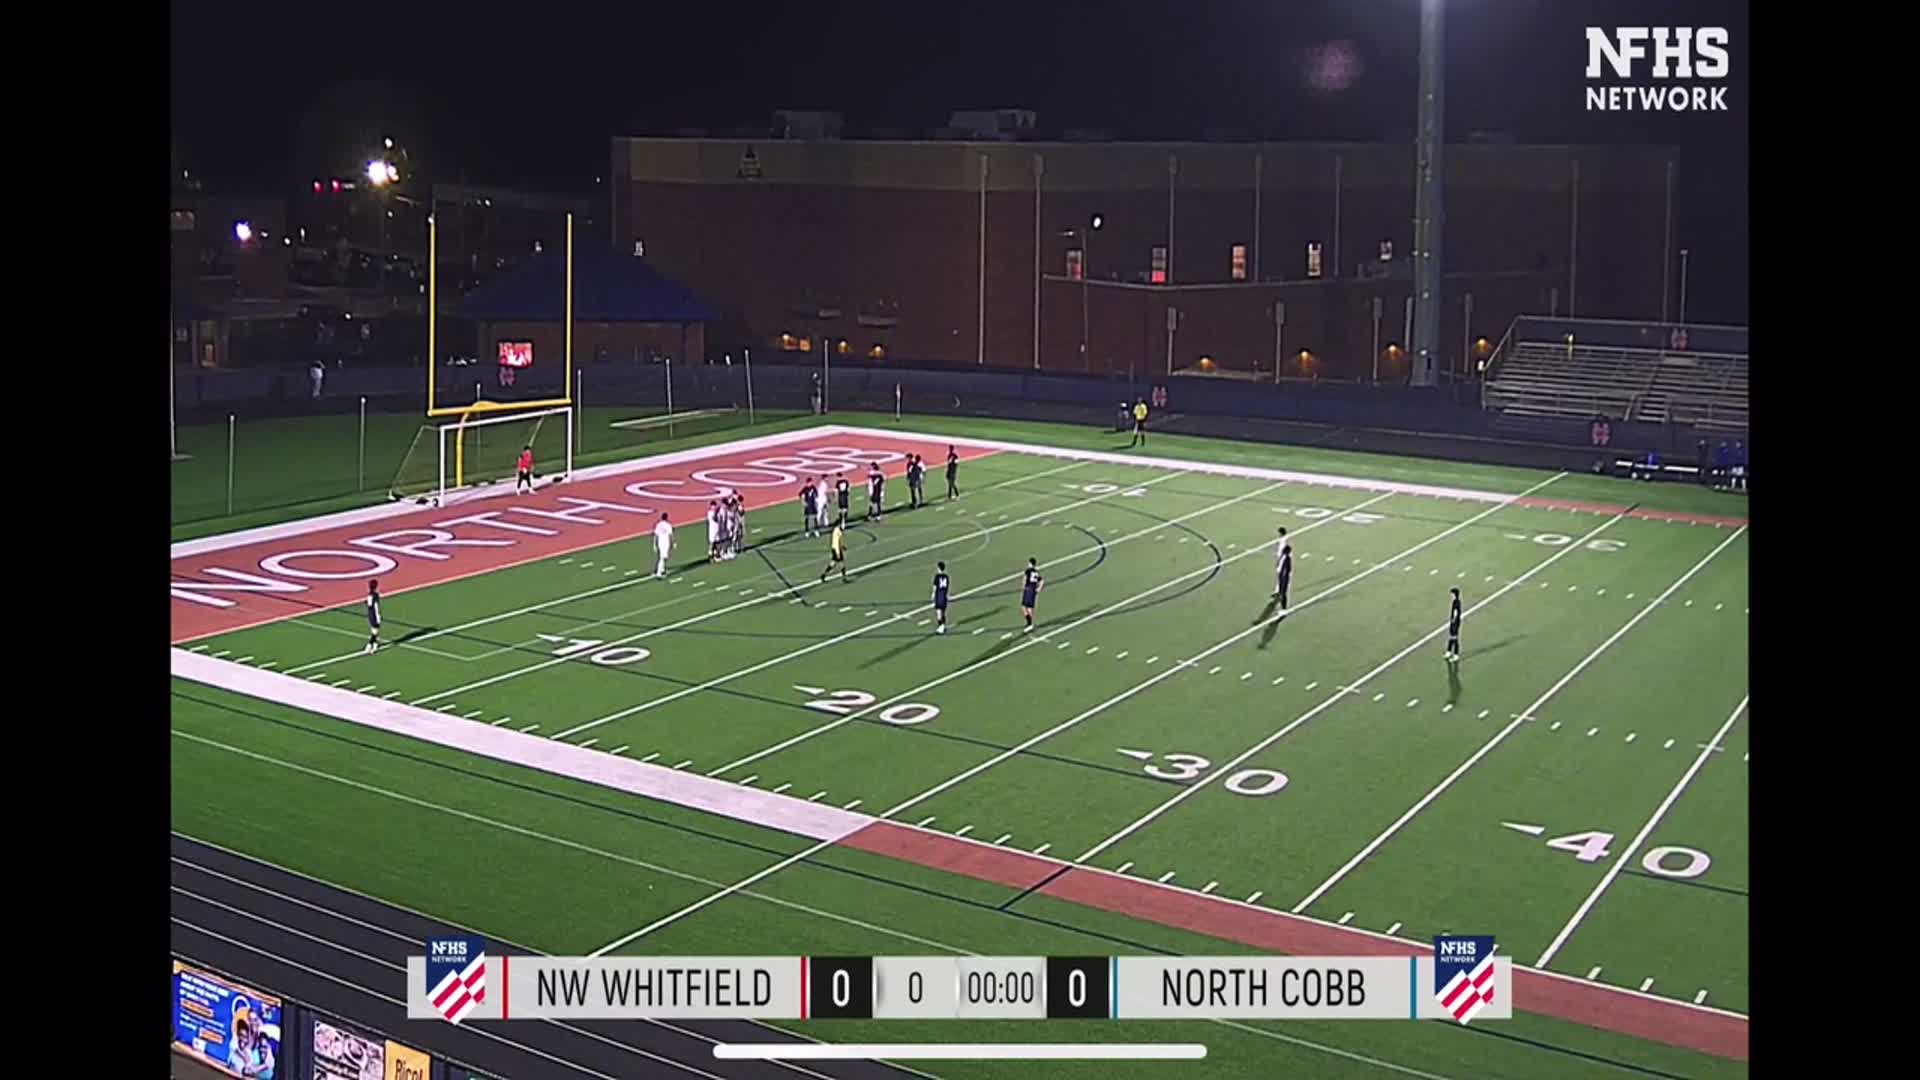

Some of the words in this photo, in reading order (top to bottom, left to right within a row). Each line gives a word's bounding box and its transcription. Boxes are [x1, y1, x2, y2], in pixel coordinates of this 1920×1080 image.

[171, 496, 656, 608] NORTH
[624, 446, 907, 501] COBB
[551, 637, 652, 666] 10
[804, 689, 941, 726] 20
[1143, 753, 1290, 796] 30
[1545, 830, 1712, 879] 40
